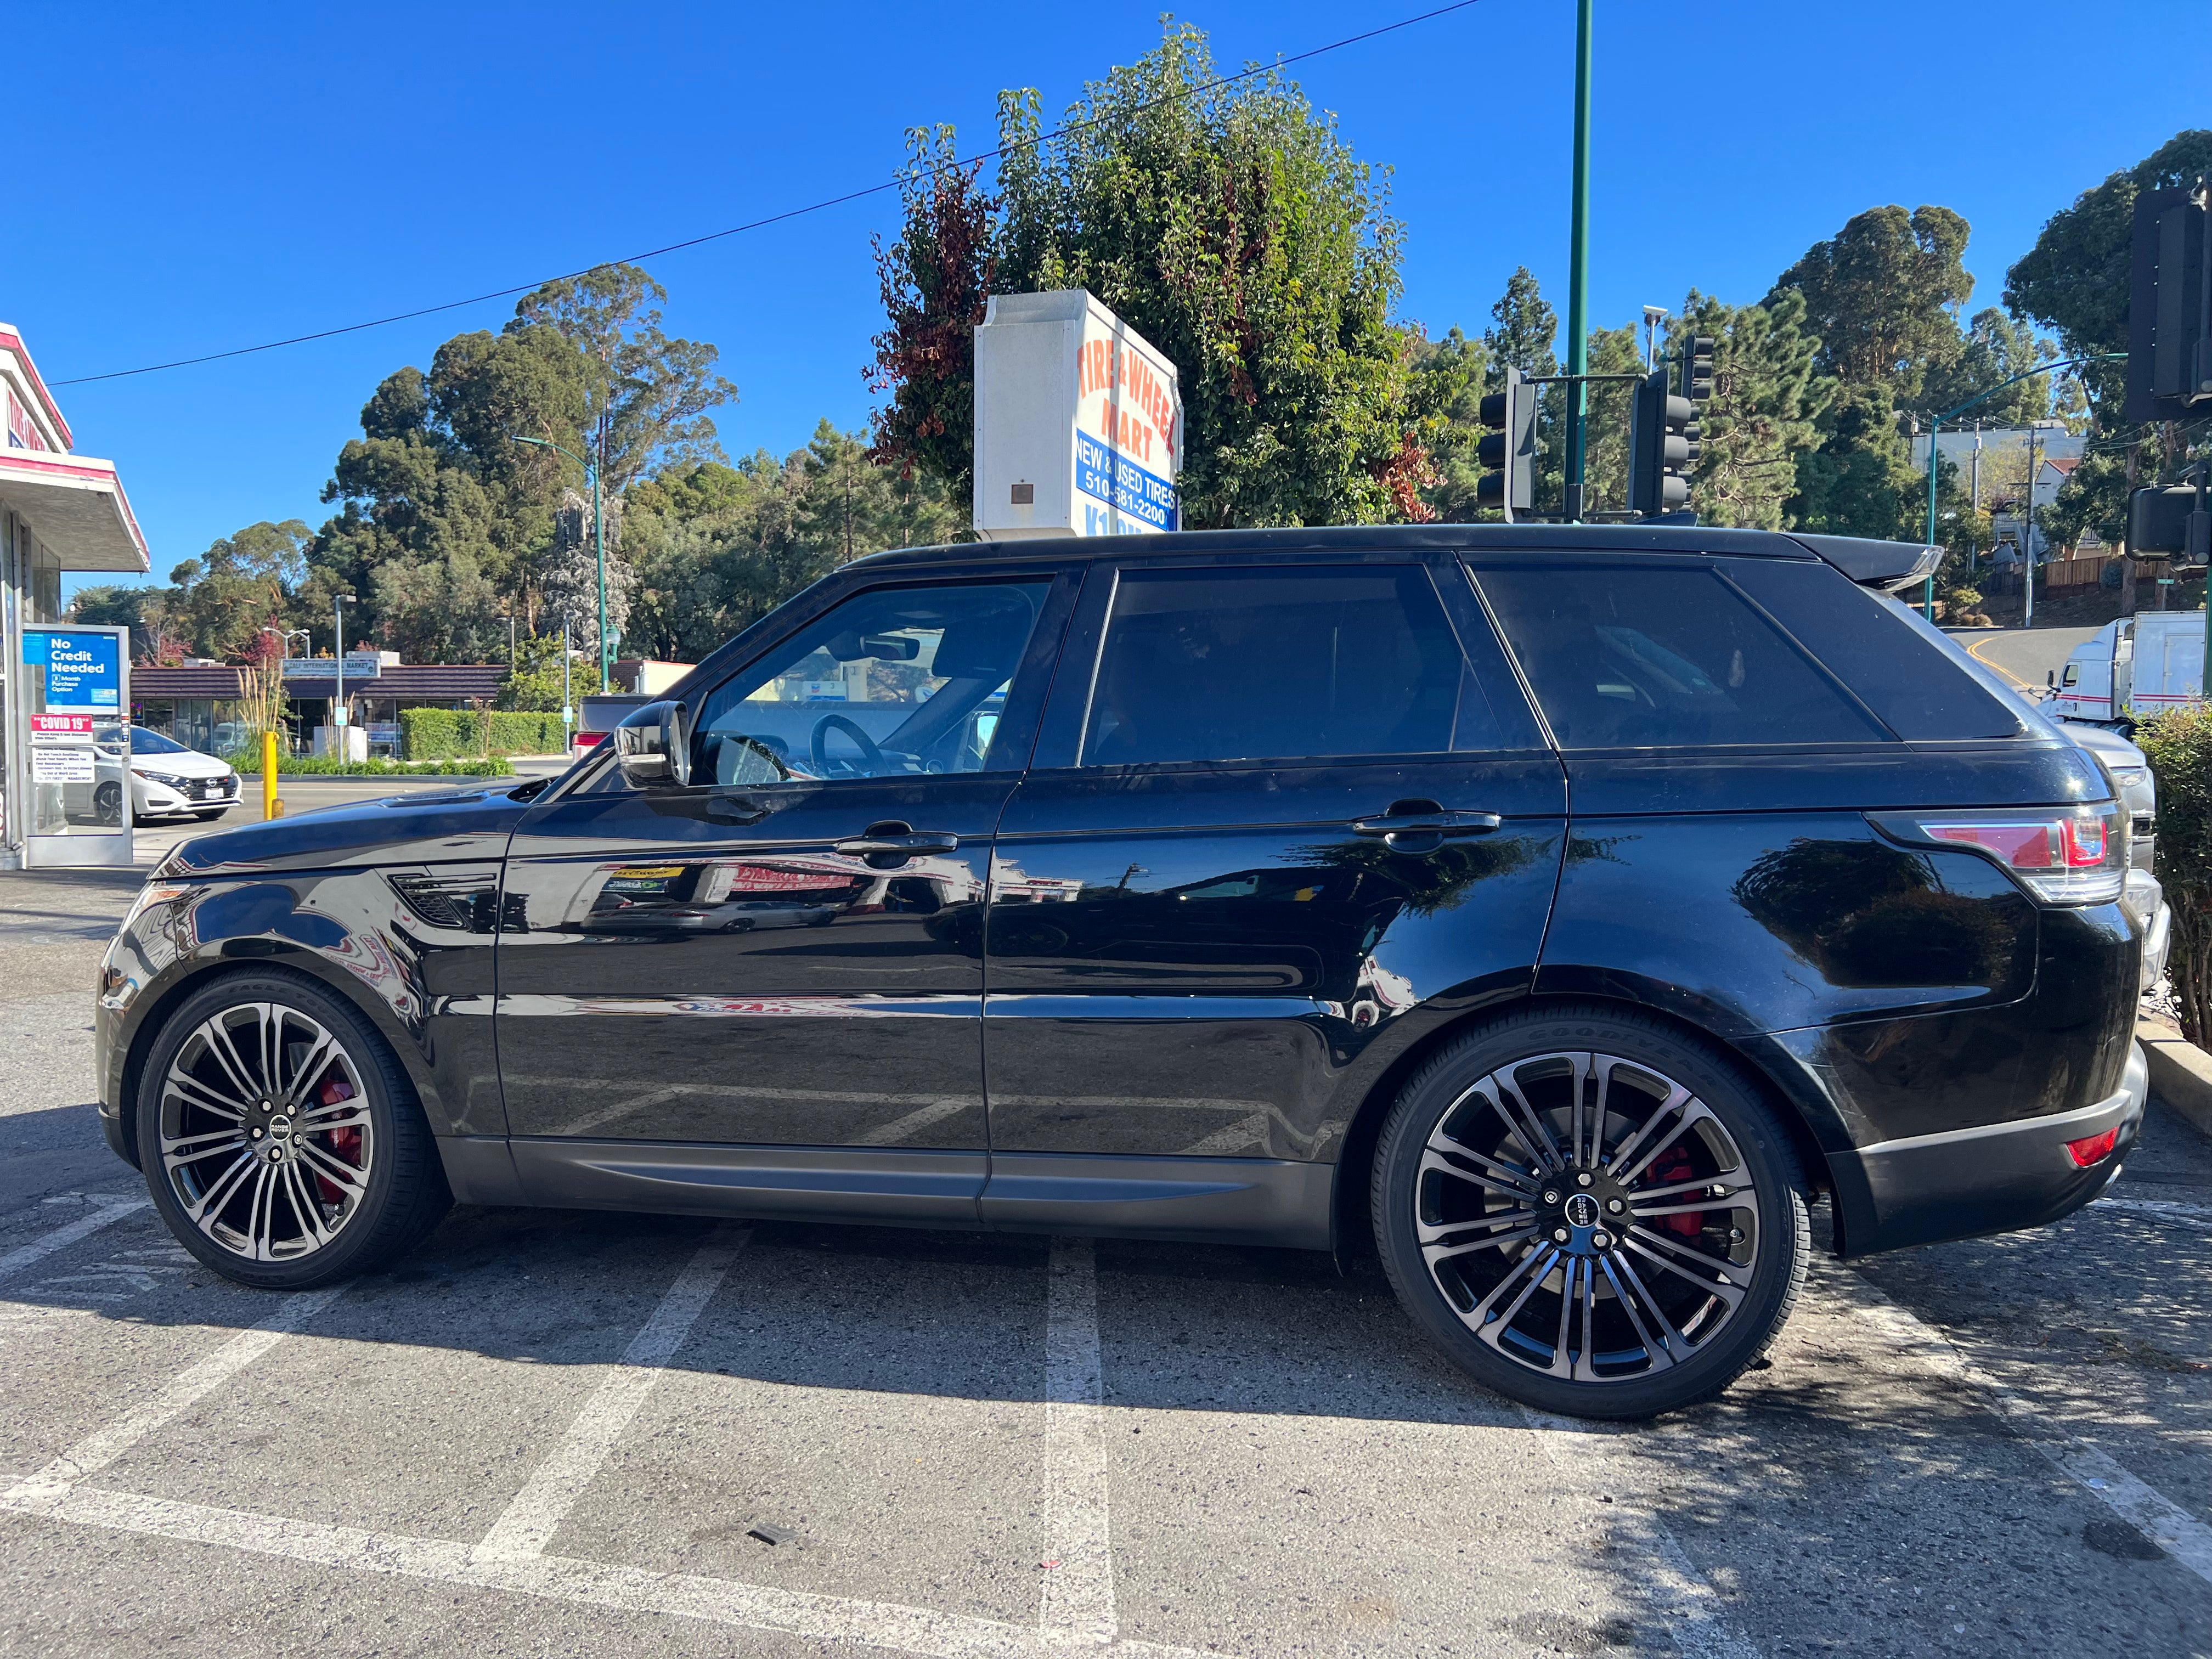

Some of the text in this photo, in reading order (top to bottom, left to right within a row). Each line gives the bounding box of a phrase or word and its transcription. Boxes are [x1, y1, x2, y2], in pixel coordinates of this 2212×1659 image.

[1077, 339, 1176, 459] TIRE & WHEEL
[1102, 398, 1153, 462] MART
[1076, 438, 1176, 510] NEW & USED TIRES
[1086, 470, 1165, 525] 510-581-2200
[51, 638, 71, 648] No
[51, 651, 92, 662] Credit
[51, 662, 104, 674] Needed
